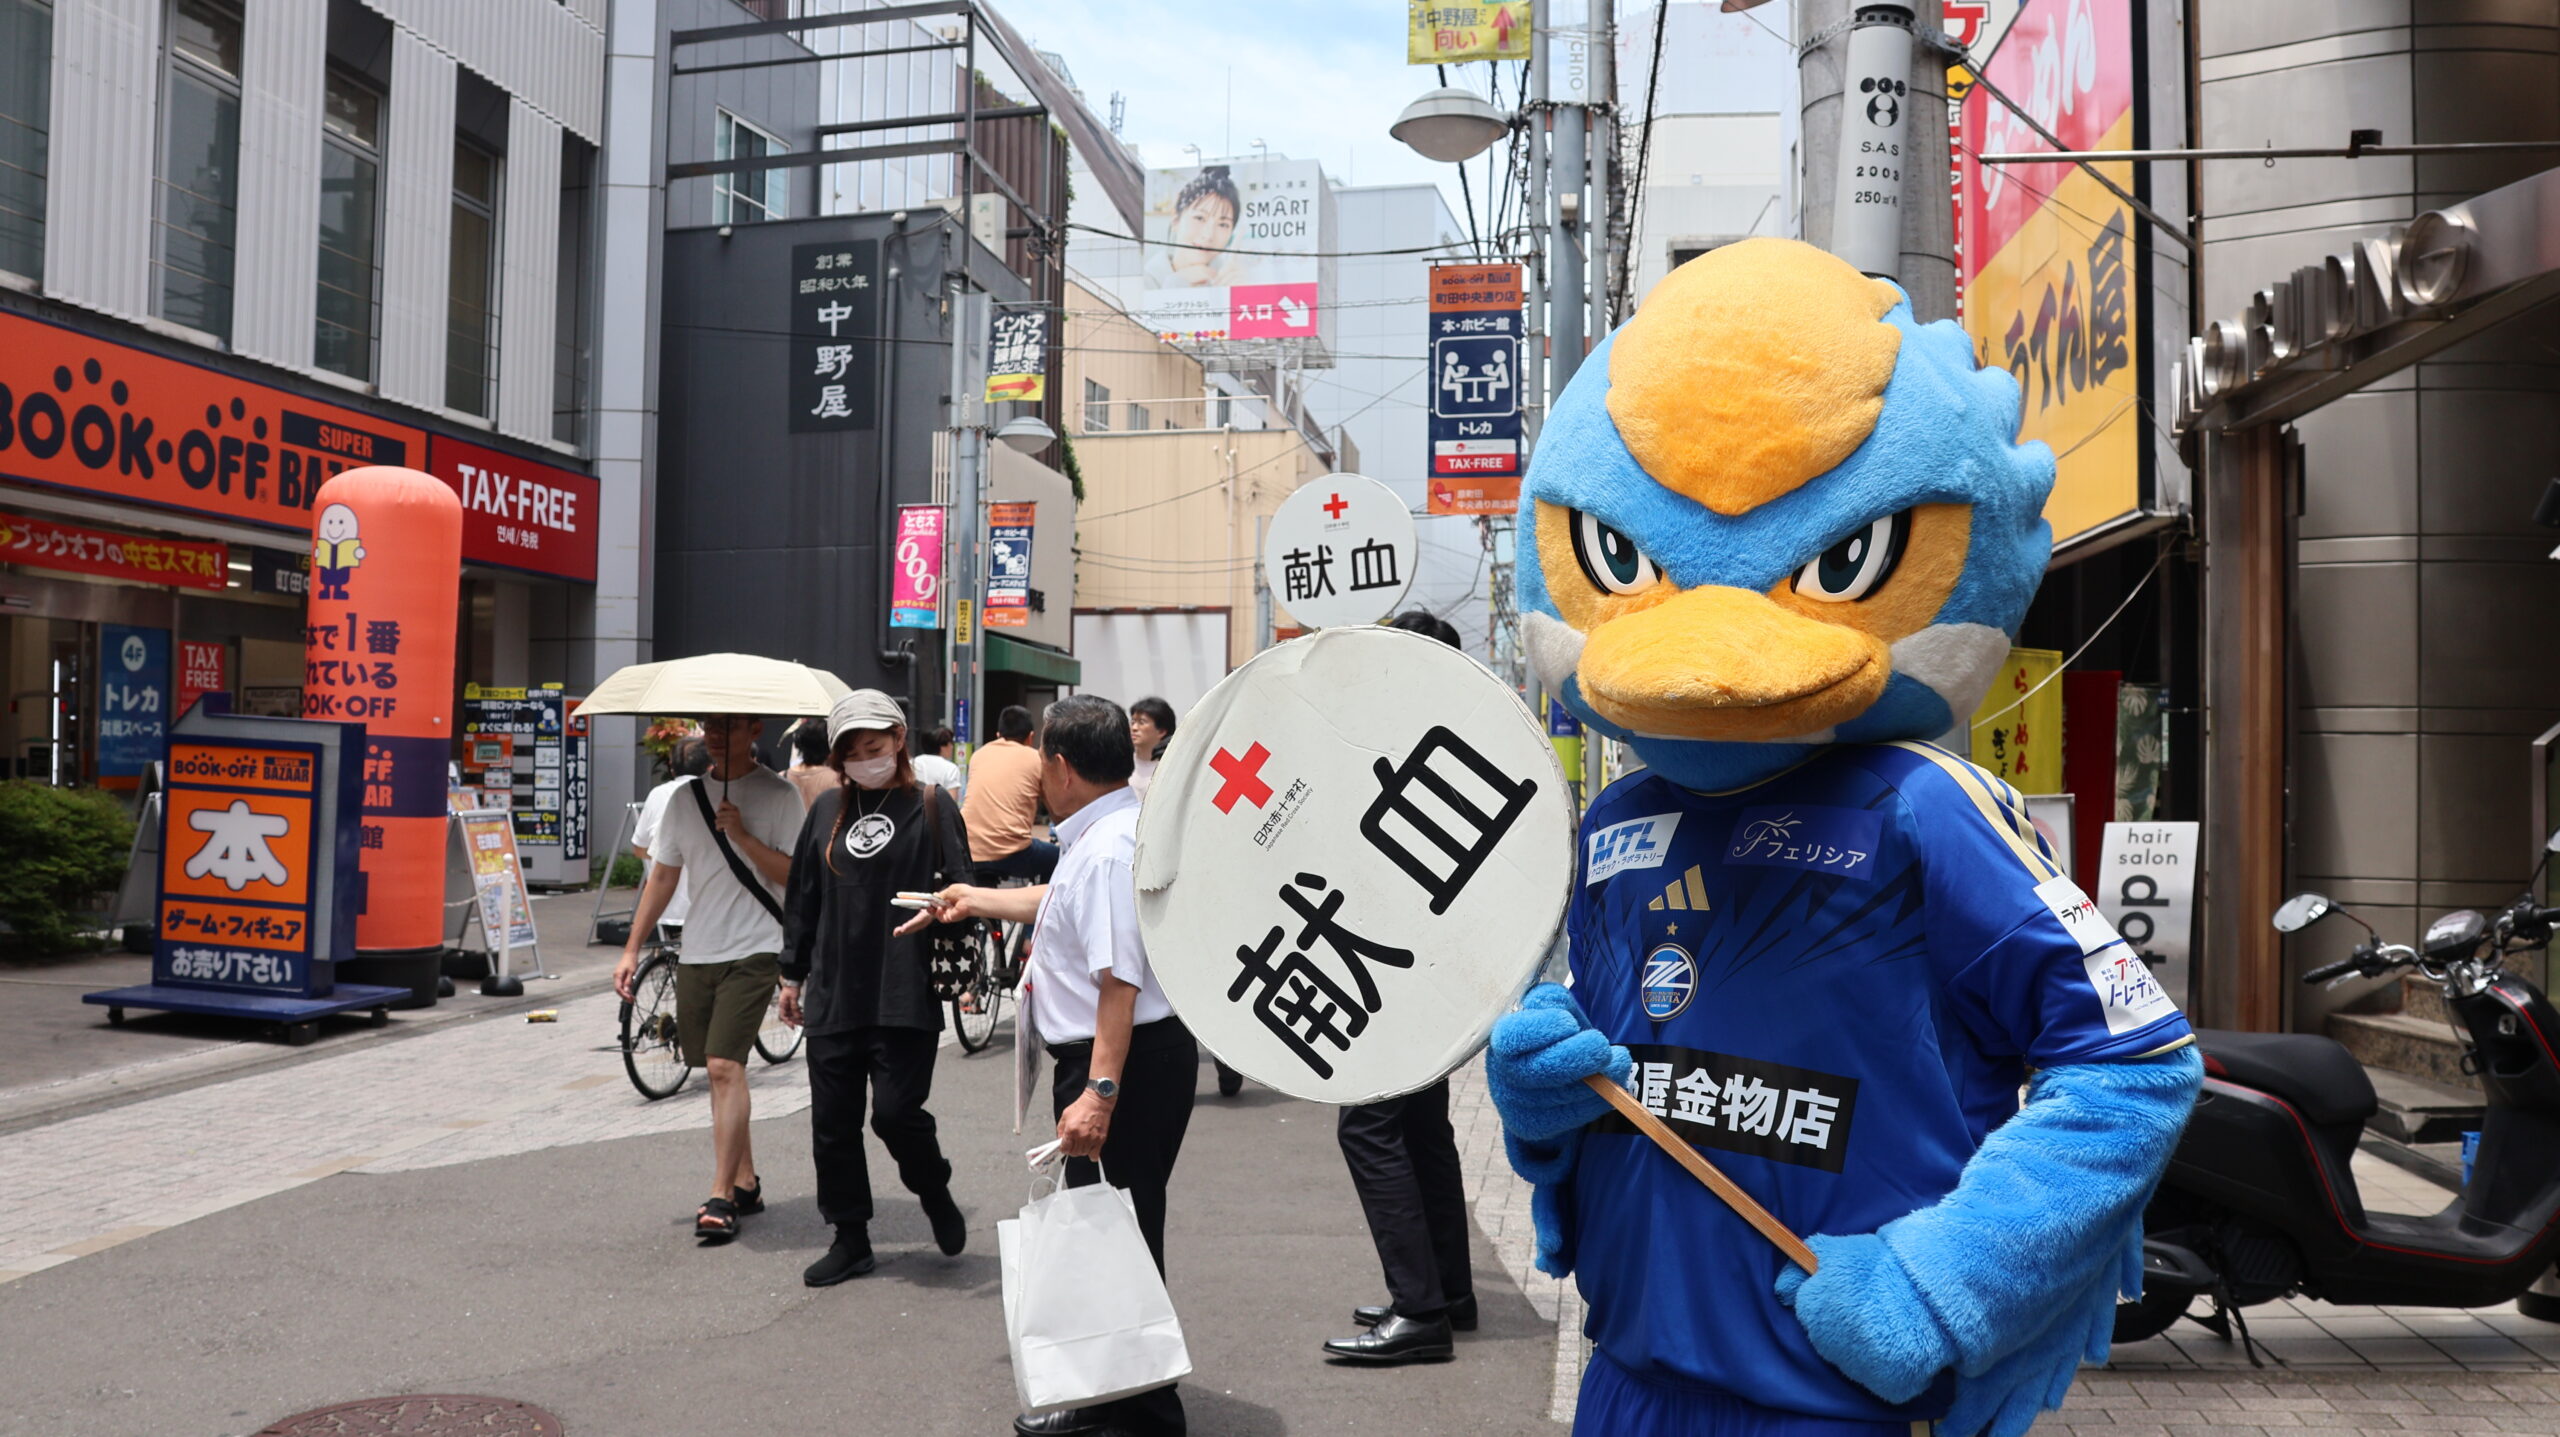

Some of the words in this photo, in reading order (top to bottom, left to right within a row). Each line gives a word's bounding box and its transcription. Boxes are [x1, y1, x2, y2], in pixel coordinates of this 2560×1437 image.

[1426, 8, 1478, 28] 中野屋
[1434, 29, 1477, 51] 向い
[1246, 199, 1309, 218] SMART
[1249, 221, 1306, 239] TOUCH
[815, 253, 853, 269] 創業
[800, 275, 869, 293] 昭和八年
[1436, 291, 1516, 303] 町田中央通り店
[994, 314, 1046, 331] インドア
[1237, 304, 1273, 322] 入口
[995, 330, 1042, 346] ゴルフ
[811, 300, 853, 419] 中野屋
[1459, 421, 1492, 435] トレカ
[319, 425, 373, 457] SUPER
[1448, 457, 1503, 469] TAX-FREE
[458, 464, 576, 533] TAX-FREE
[1282, 538, 1401, 602] 献血
[125, 645, 143, 661] 4F
[185, 645, 219, 669] TAX
[186, 670, 219, 689] FREE
[105, 683, 160, 712] トレカ
[2015, 668, 2029, 774] らーめん
[263, 766, 309, 783] BAZAAR
[1253, 777, 1307, 846] 日本赤十字社
[1265, 829, 1283, 852] Japanese
[1288, 805, 1301, 819] Cross
[1298, 787, 1314, 806] Society
[185, 800, 288, 891] 本
[1593, 821, 1656, 866] MTL
[2127, 828, 2173, 844] hair
[1766, 842, 1867, 870] フェリシア
[2119, 852, 2178, 865] salon
[1226, 725, 1539, 1080] 献血
[166, 909, 301, 941] ゲーム・フィギュア
[171, 948, 292, 983] お売り下さい
